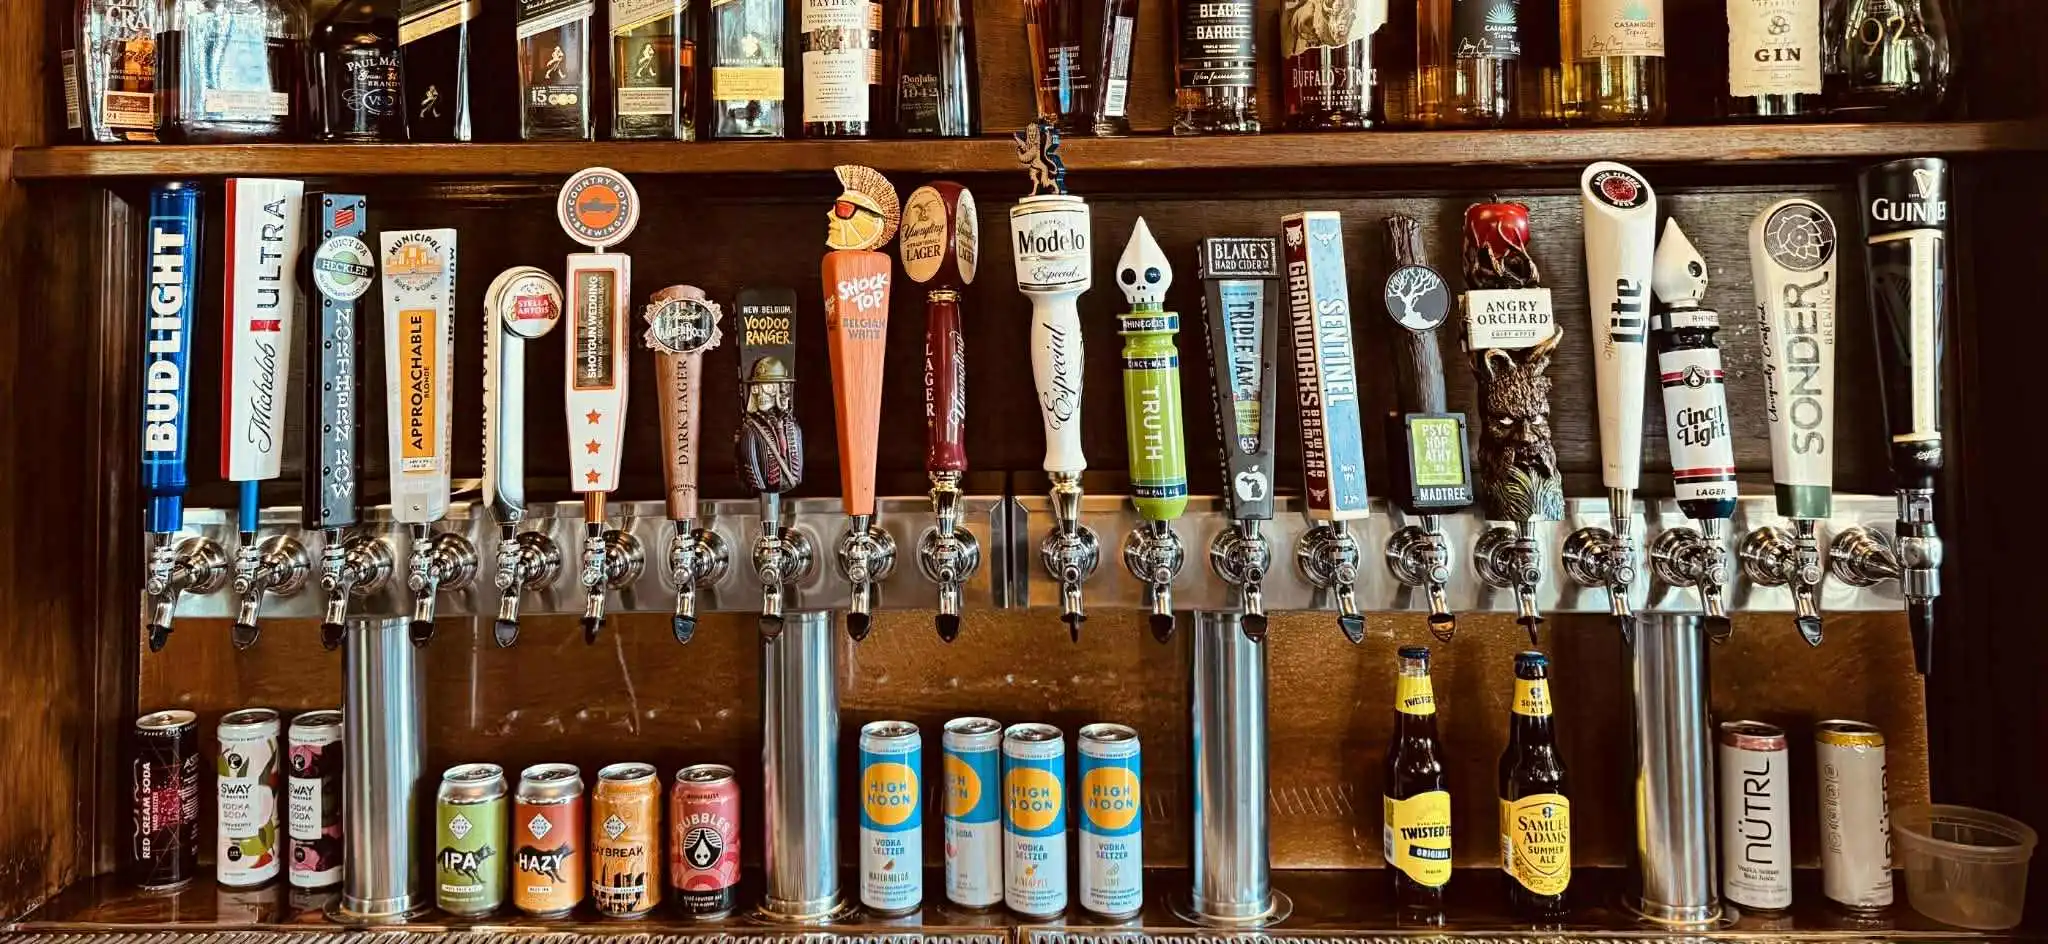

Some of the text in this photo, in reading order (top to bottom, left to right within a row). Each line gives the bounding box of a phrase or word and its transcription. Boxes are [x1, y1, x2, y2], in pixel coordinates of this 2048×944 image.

[1200, 4, 1241, 18] BLACK
[1754, 48, 1801, 62] GIN
[346, 59, 378, 71] PAUL
[532, 89, 547, 103] 15
[568, 177, 628, 208] COUNTRY BOY
[573, 220, 622, 236] BREWING
[389, 233, 441, 255] MUNICIPAL
[1018, 228, 1085, 254] Modelo
[257, 194, 287, 309] ULTRA
[906, 245, 941, 262] LAGER
[1214, 243, 1269, 260] BLAKE'S
[322, 260, 368, 276] HECKLER
[1215, 259, 1238, 270] HARD
[1239, 260, 1262, 269] CIDER
[838, 272, 888, 301] SHOCK
[743, 305, 758, 314] NEW
[852, 290, 885, 312] TOP
[1486, 300, 1538, 314] ANGRY
[1477, 312, 1548, 325] ORCHARD
[1611, 277, 1645, 345] Lite
[1824, 286, 1832, 346] BREWING
[588, 275, 598, 379] SHOTGUN WEDDING
[744, 315, 790, 331] VOODOO
[1229, 301, 1254, 352] TRIPLE
[146, 227, 186, 452] BUD LIGHT
[745, 330, 791, 345] RANGER
[1288, 261, 1319, 412] GRAINWORKS
[1318, 299, 1357, 408] SENTINEL
[1235, 357, 1254, 387] JAM
[1783, 271, 1830, 456] SONDER
[411, 315, 423, 450] APPROACHABLE
[925, 343, 936, 418] LAGER
[1041, 322, 1077, 431] Especial
[248, 338, 276, 454] Michelob
[1763, 363, 1780, 422] Uniquely
[332, 308, 353, 499] NORTHERN ROW
[678, 358, 689, 465] DARK LAGER
[1141, 386, 1162, 461] TRUTH
[1676, 404, 1722, 433] Cincy
[1676, 419, 1726, 448] Light
[1301, 410, 1316, 478] COMPANY
[1311, 408, 1326, 479] BREWING
[1420, 487, 1466, 500] MADTREE
[1695, 488, 1727, 497] LAGER
[220, 783, 252, 794] SWAY
[871, 783, 907, 793] HIGH
[1012, 784, 1050, 798] HIGH
[1093, 784, 1130, 797] HIGH
[868, 795, 911, 806] NOON
[1090, 799, 1133, 809] NOON
[143, 761, 151, 859] RED CREAM SODA
[676, 812, 730, 834] BUBBLES
[1518, 816, 1569, 832] SAMUEL
[1401, 826, 1444, 840] TWISTED
[1523, 833, 1567, 845] ADAMS
[872, 847, 905, 856] SELTZER
[875, 839, 902, 847] VODKA
[1017, 842, 1044, 851] VODKA
[1099, 843, 1125, 851] VODKA
[1528, 845, 1564, 854] SUMMER
[444, 851, 477, 870] IPA
[519, 852, 563, 870] HAZY
[1096, 851, 1128, 860] SELTZER
[1540, 856, 1557, 864] ALE
